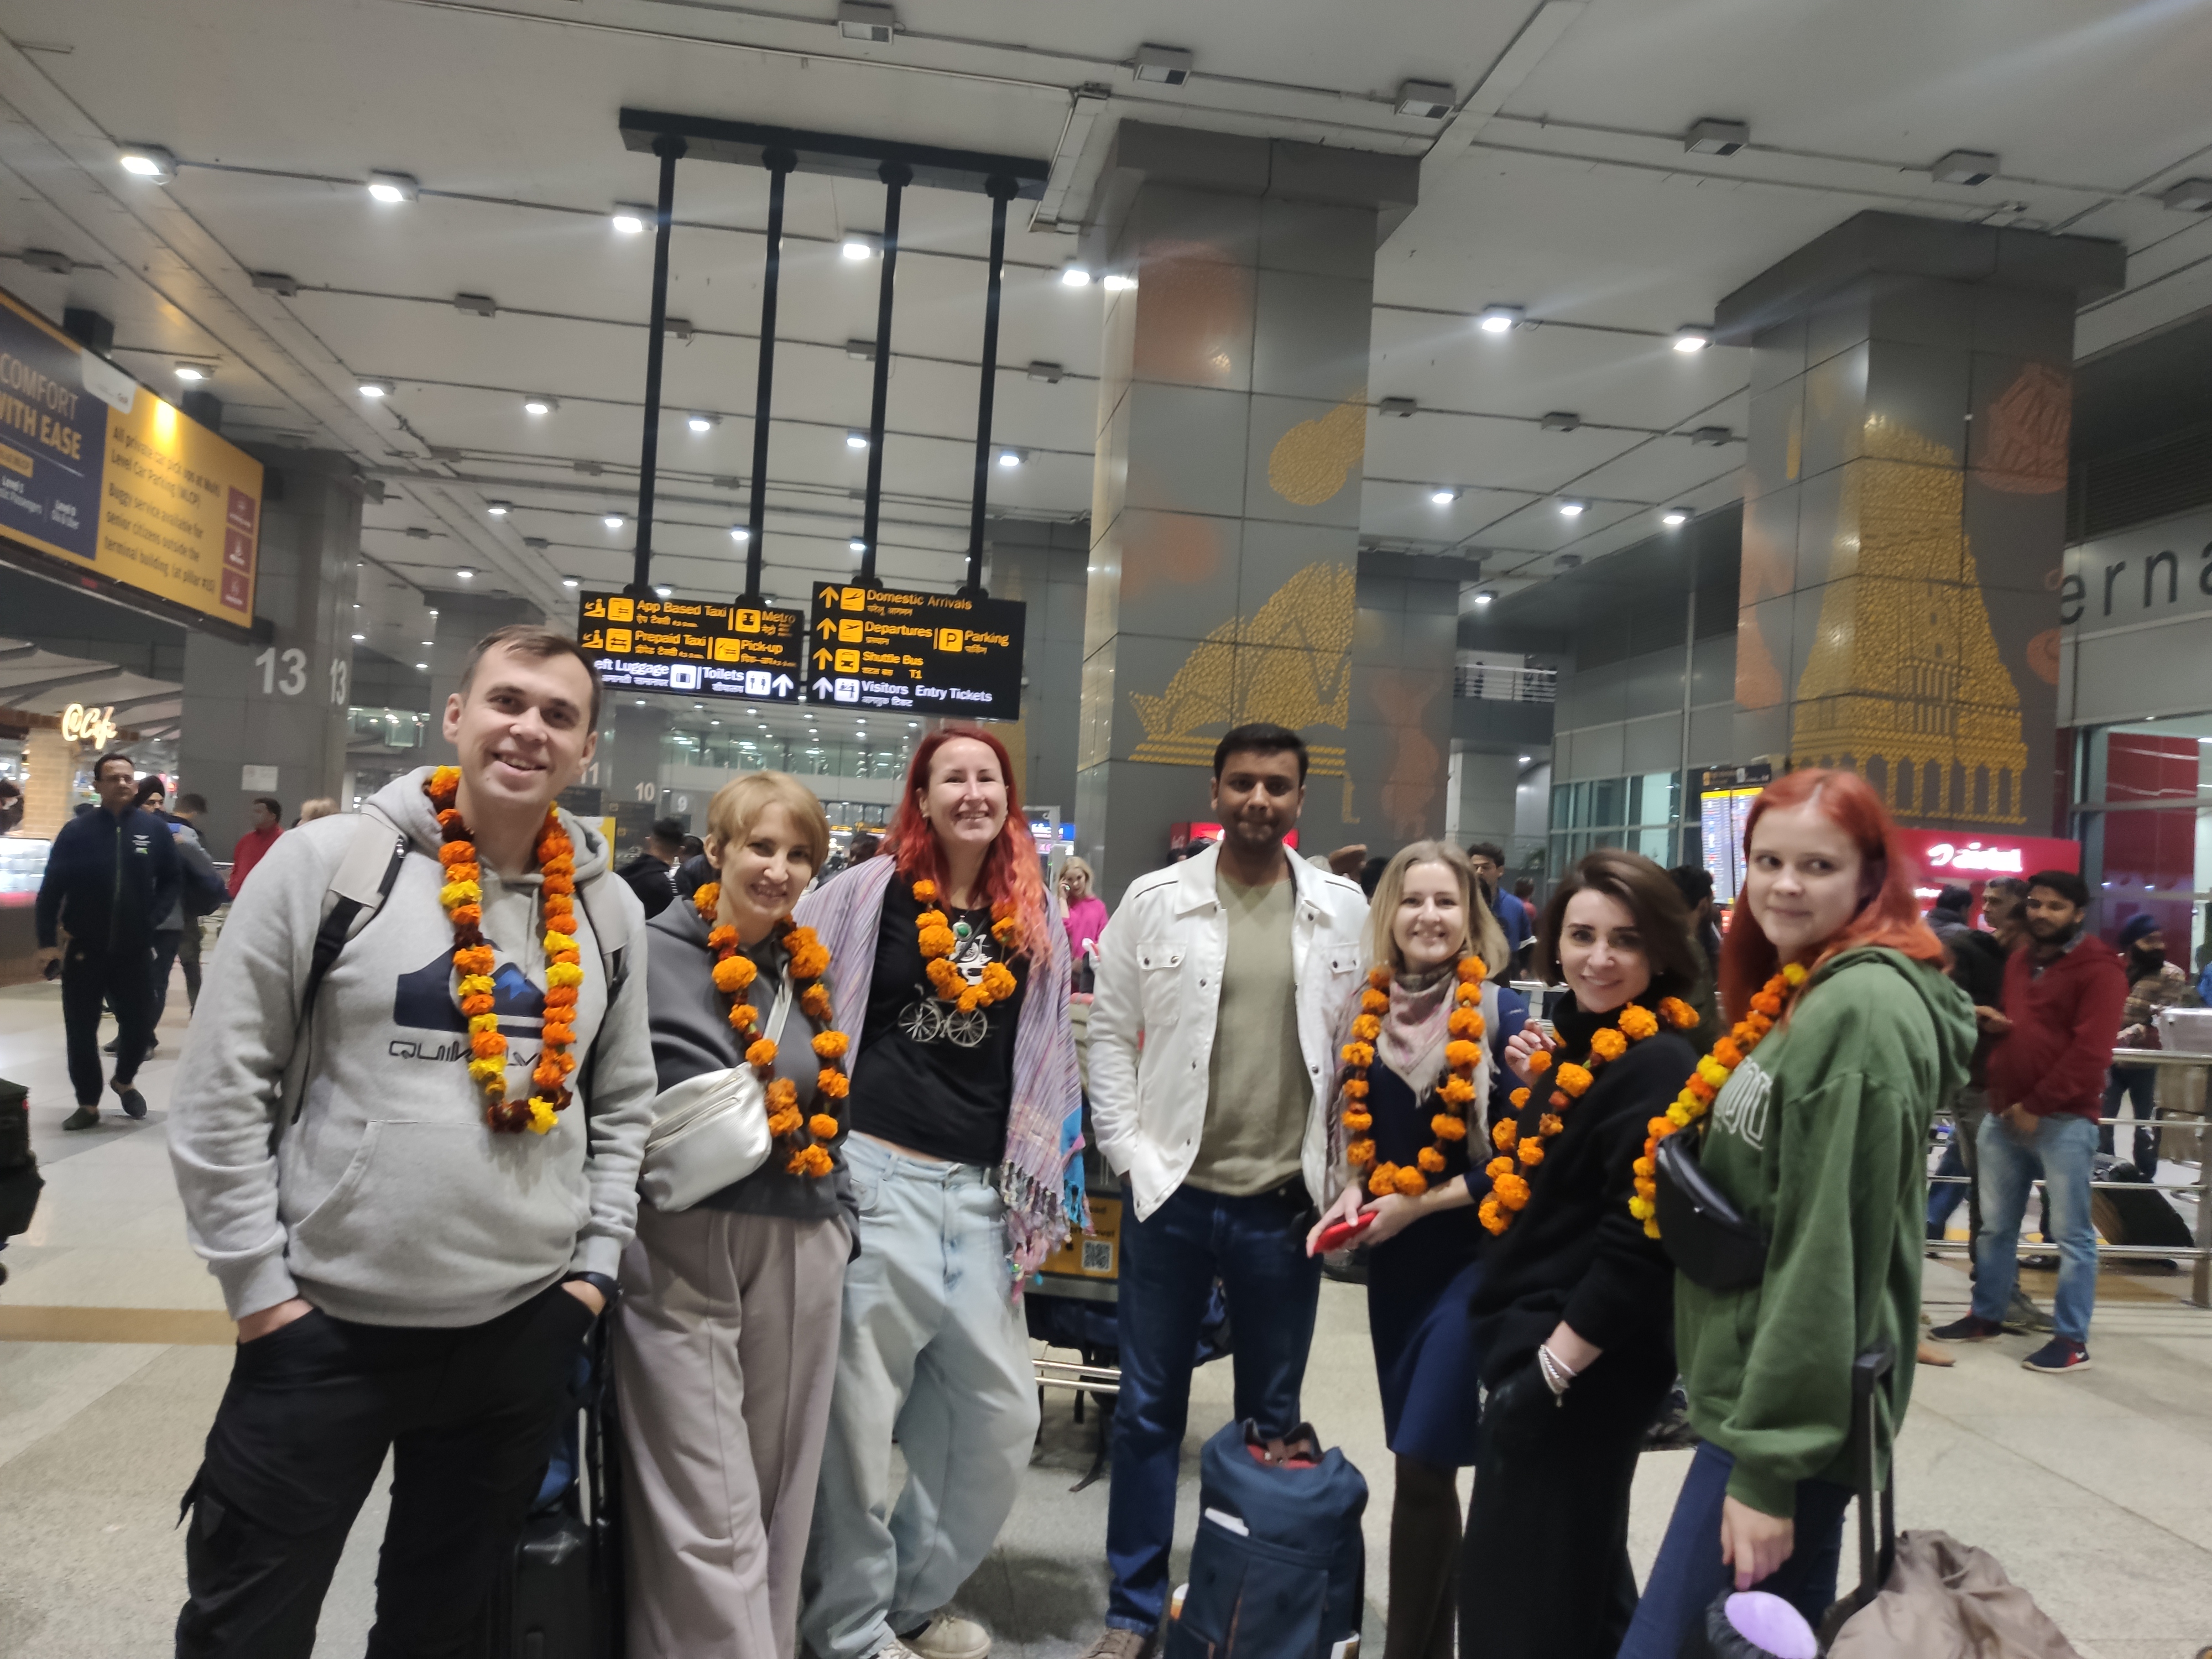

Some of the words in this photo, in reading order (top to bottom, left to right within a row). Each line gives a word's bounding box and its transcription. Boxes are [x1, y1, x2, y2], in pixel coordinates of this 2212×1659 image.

[40, 414, 82, 460] EASE
[637, 599, 661, 613] App
[663, 602, 702, 615] Based
[704, 606, 727, 617] Taxi
[867, 589, 924, 606] Domestic
[927, 596, 973, 610] Arrivals
[762, 611, 796, 624] Metro
[635, 630, 681, 644] Prepaid
[683, 634, 707, 646] Taxi
[864, 620, 933, 638] Departures
[964, 629, 1010, 647] Parking
[741, 639, 784, 655] Pick-up
[946, 632, 958, 646] P
[593, 658, 613, 670] eft
[615, 659, 670, 677] Luggage
[862, 651, 901, 664] Shuttle
[902, 655, 924, 666] Bus
[255, 646, 307, 696] 13
[702, 666, 744, 681] Toilets
[909, 669, 922, 679] T1
[330, 658, 347, 705] 13
[861, 680, 909, 695] Visitors
[915, 685, 948, 701] Entry
[949, 687, 993, 702] Tickets
[635, 781, 655, 802] 10
[677, 795, 688, 813] 9
